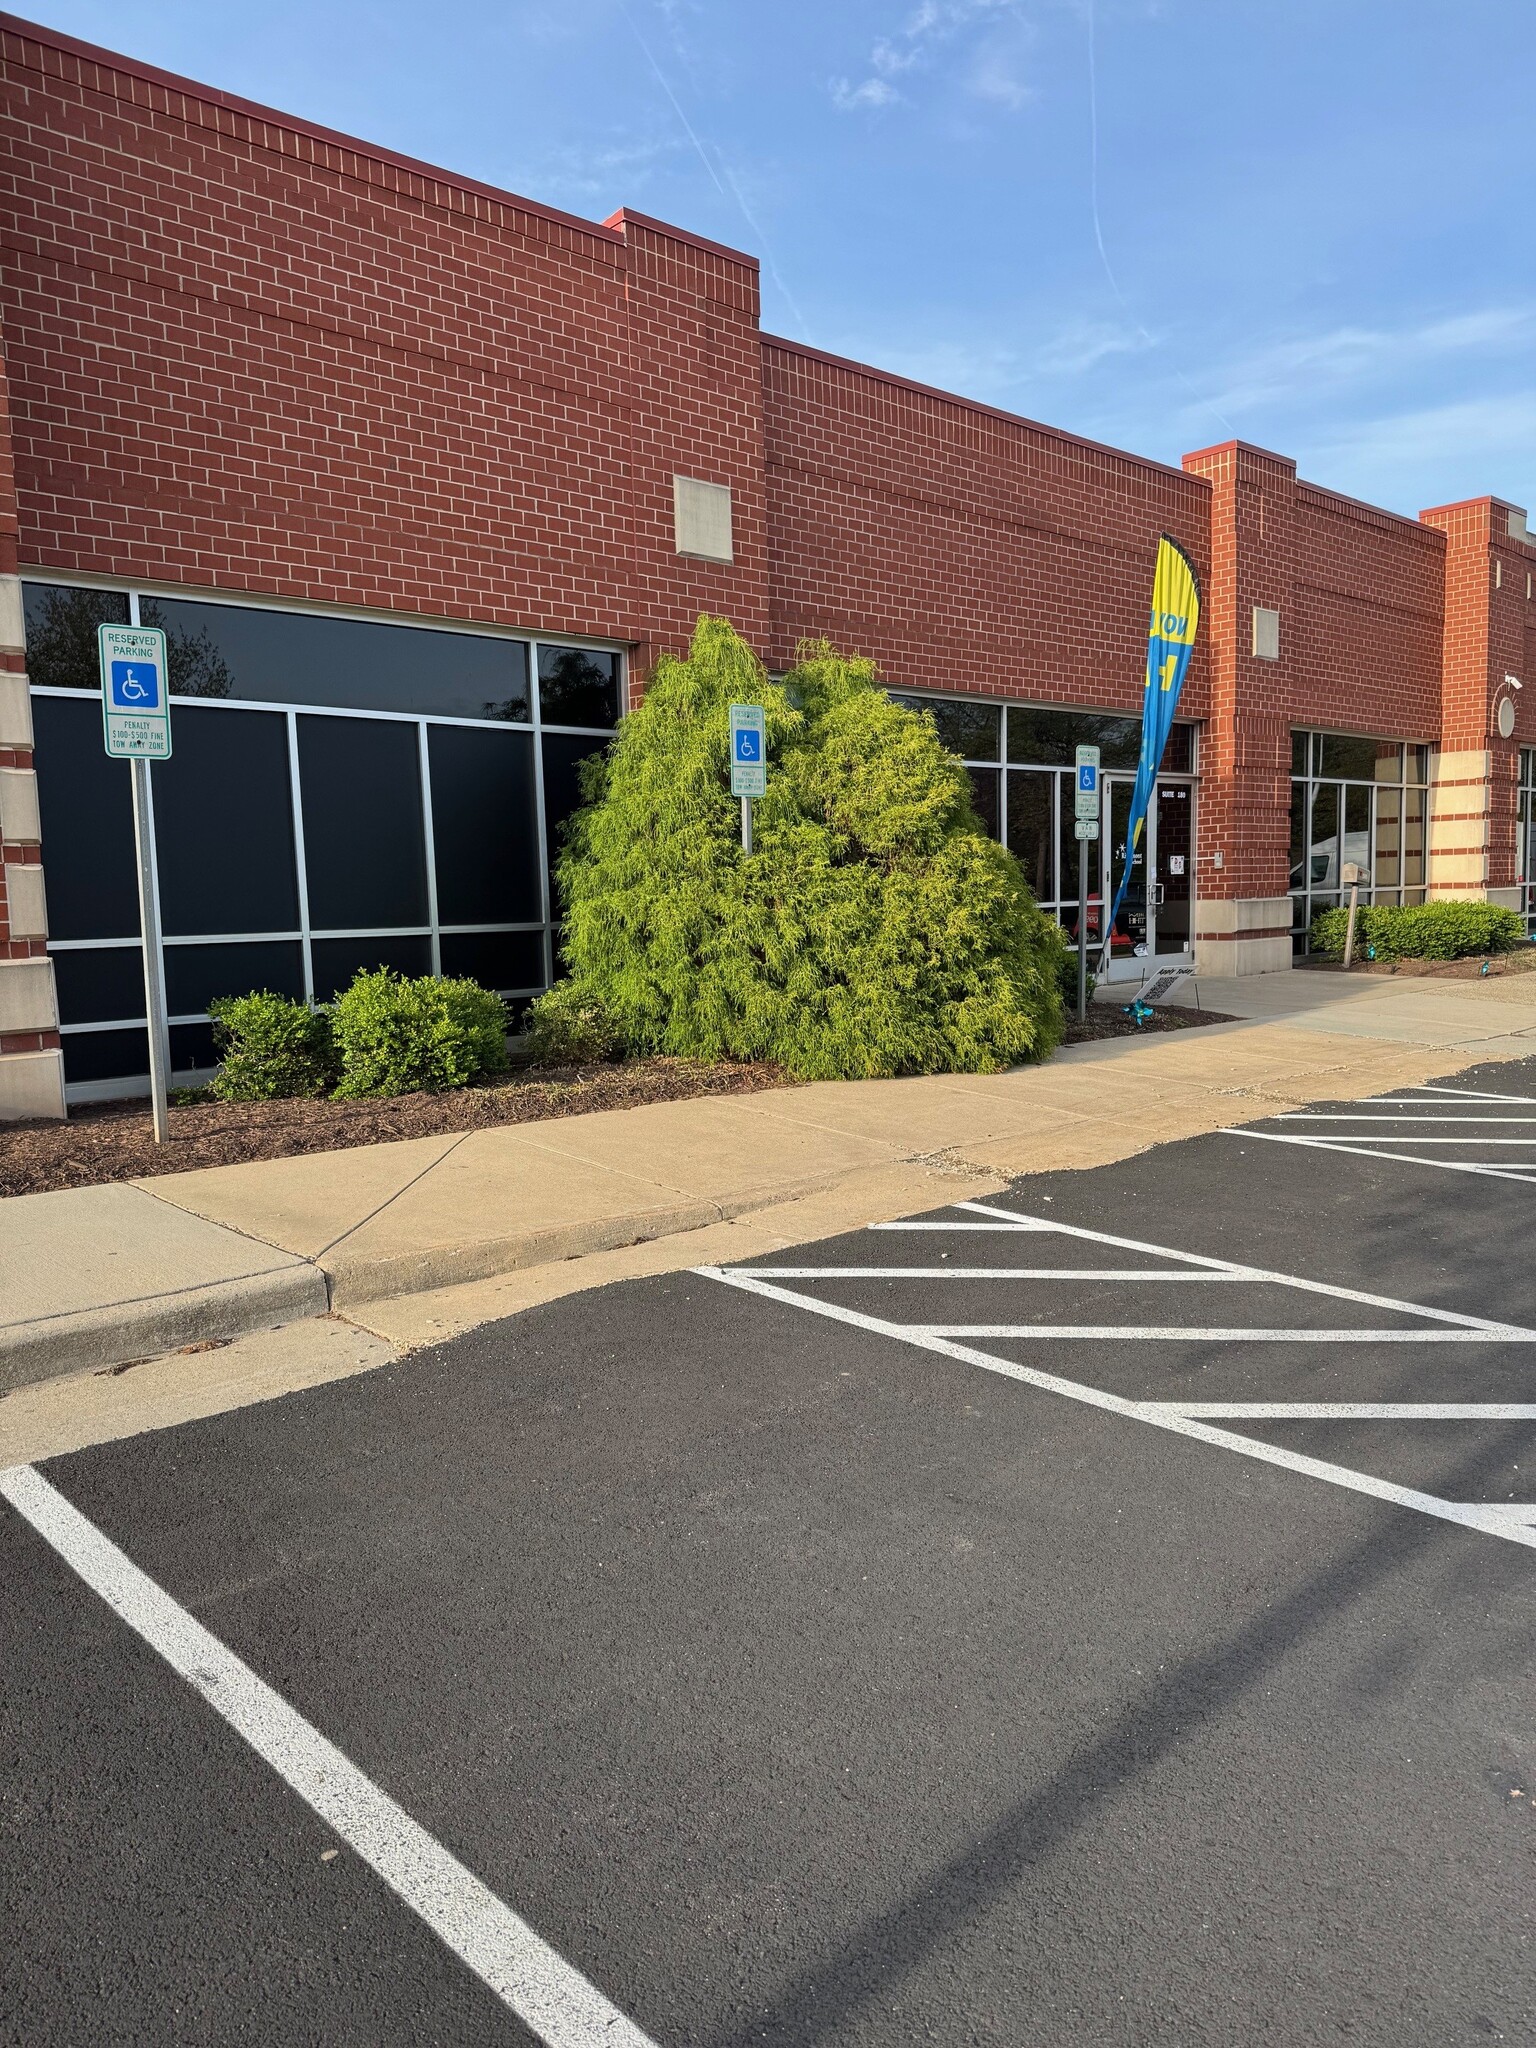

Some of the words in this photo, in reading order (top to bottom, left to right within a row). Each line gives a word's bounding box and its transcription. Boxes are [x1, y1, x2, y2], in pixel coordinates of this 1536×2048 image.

[108, 633, 157, 646] RESERVED
[113, 646, 153, 657] PARKING
[124, 721, 151, 730] PENALTY
[112, 730, 148, 740] $100-$500
[151, 732, 164, 741] FINE
[113, 740, 126, 748] TOW
[129, 740, 145, 749] AWAY
[148, 741, 164, 750] ZONE
